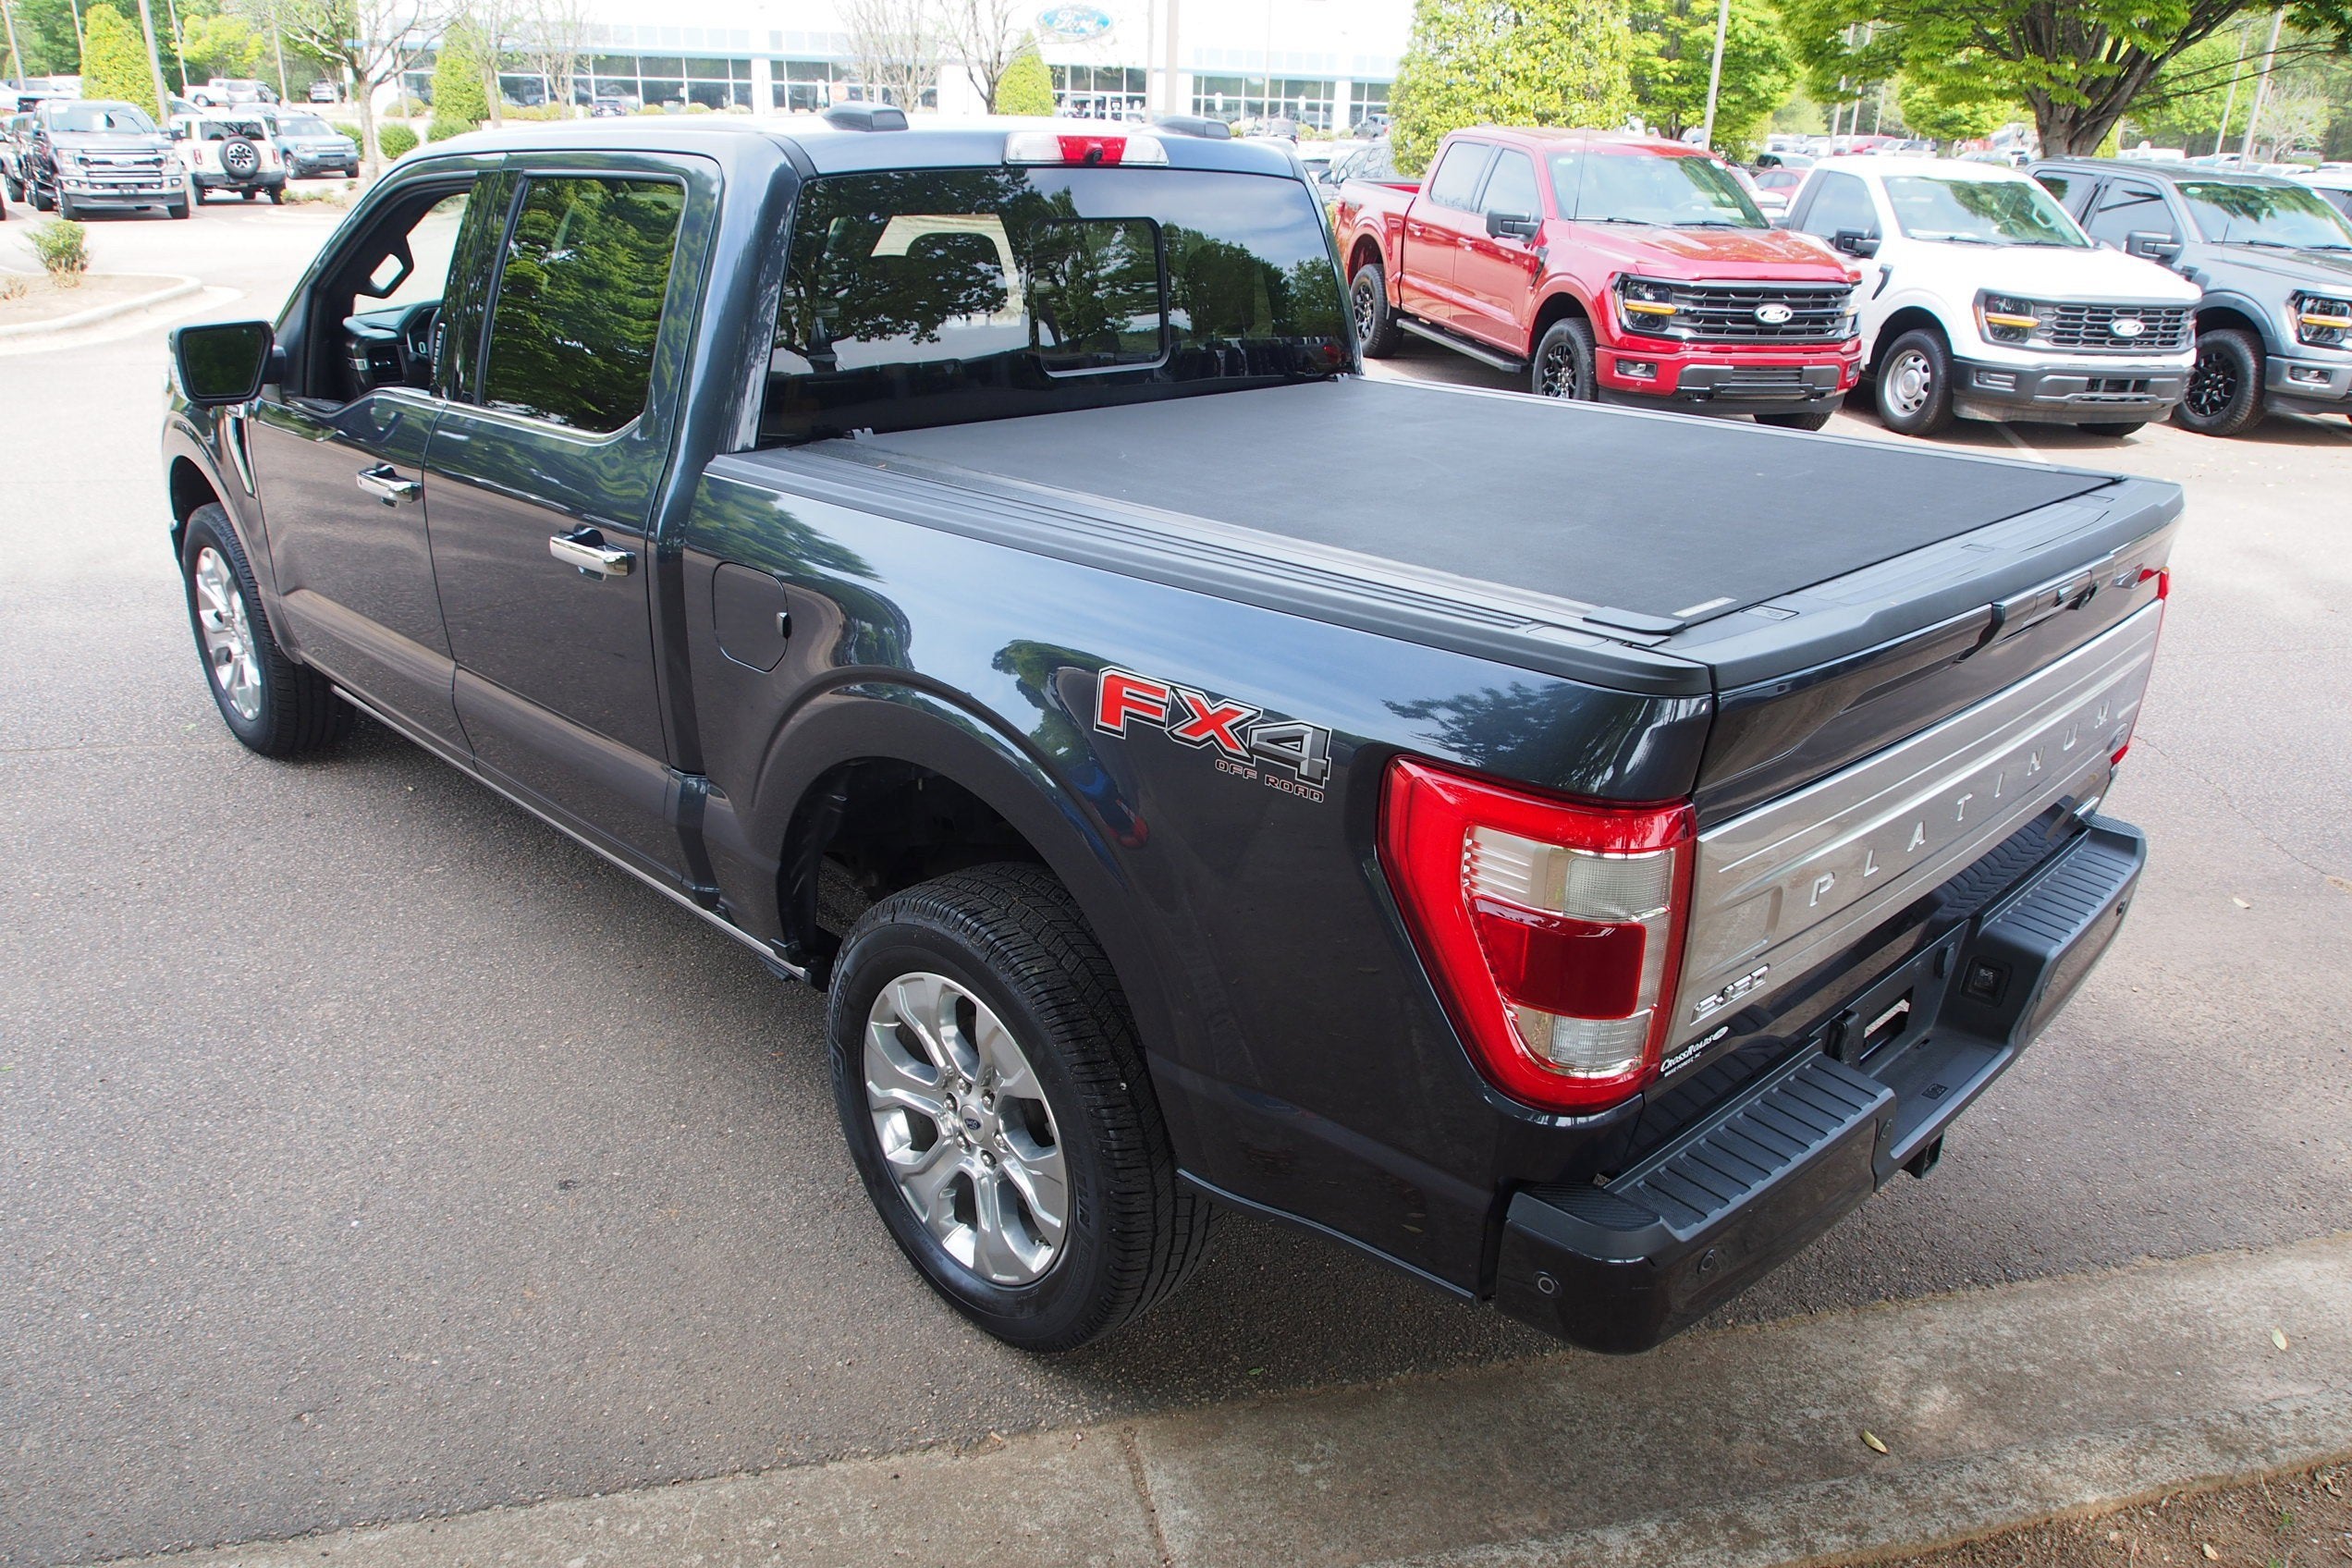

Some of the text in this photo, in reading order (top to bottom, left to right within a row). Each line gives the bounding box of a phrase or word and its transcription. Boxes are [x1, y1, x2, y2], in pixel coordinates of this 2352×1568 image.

[1052, 9, 1106, 34] Ford
[1094, 666, 1332, 789] FX4
[1215, 758, 1325, 803] OFF ROAD
[1808, 699, 2113, 907] PLATINUM
